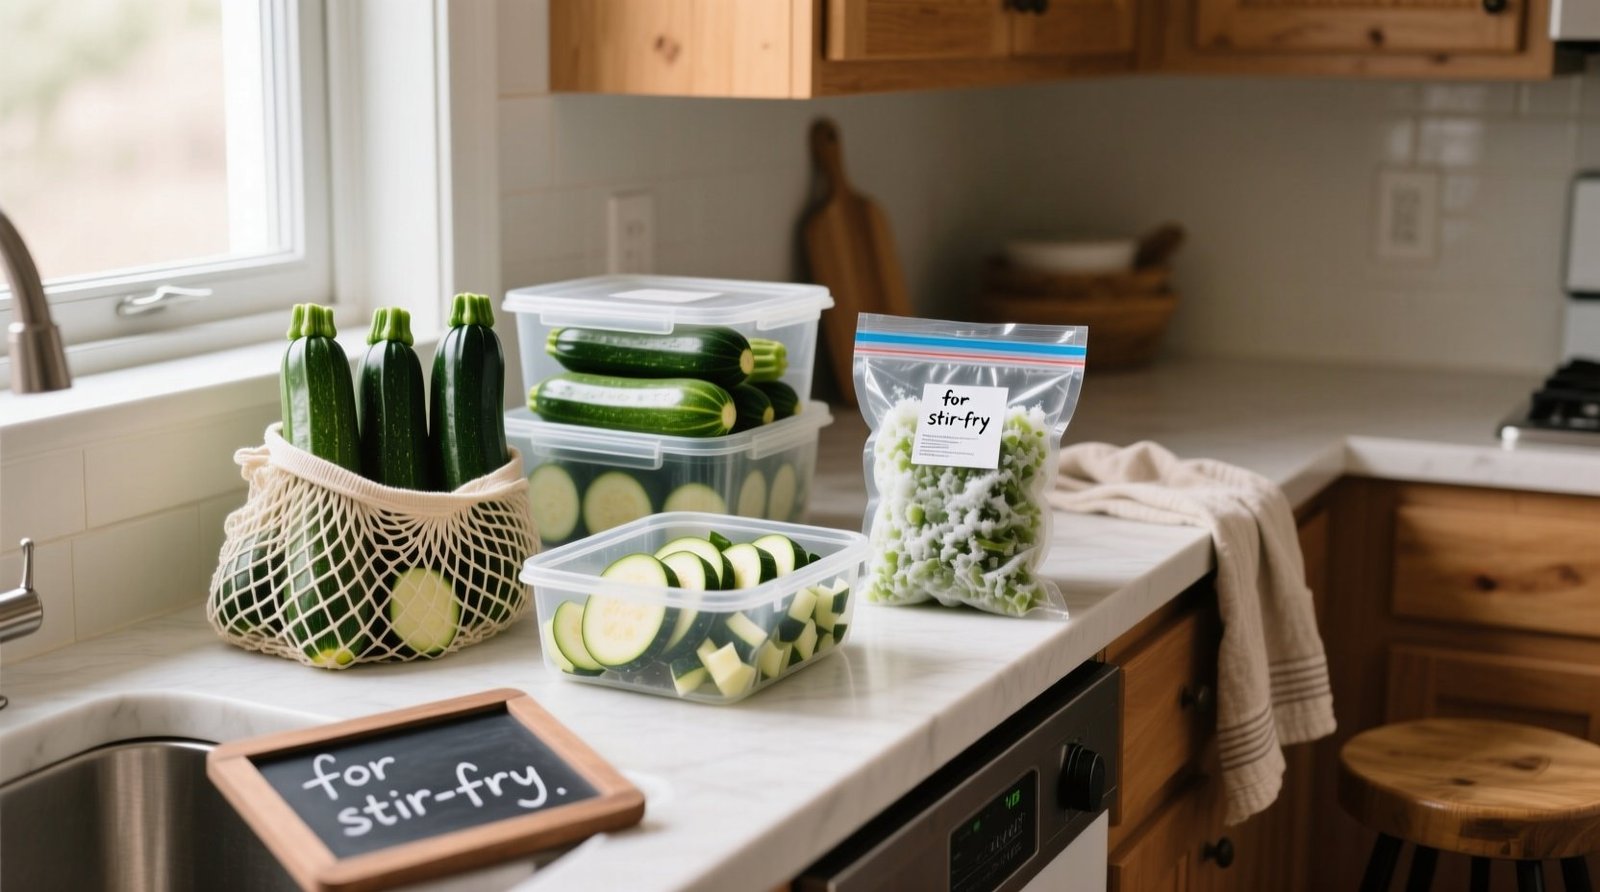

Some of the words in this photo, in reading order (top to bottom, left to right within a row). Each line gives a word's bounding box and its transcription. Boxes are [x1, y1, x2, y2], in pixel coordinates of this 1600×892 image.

[942, 389, 970, 406] for
[928, 411, 990, 435] stir-fry
[302, 753, 396, 800] for
[337, 761, 567, 837] stir-fry.
